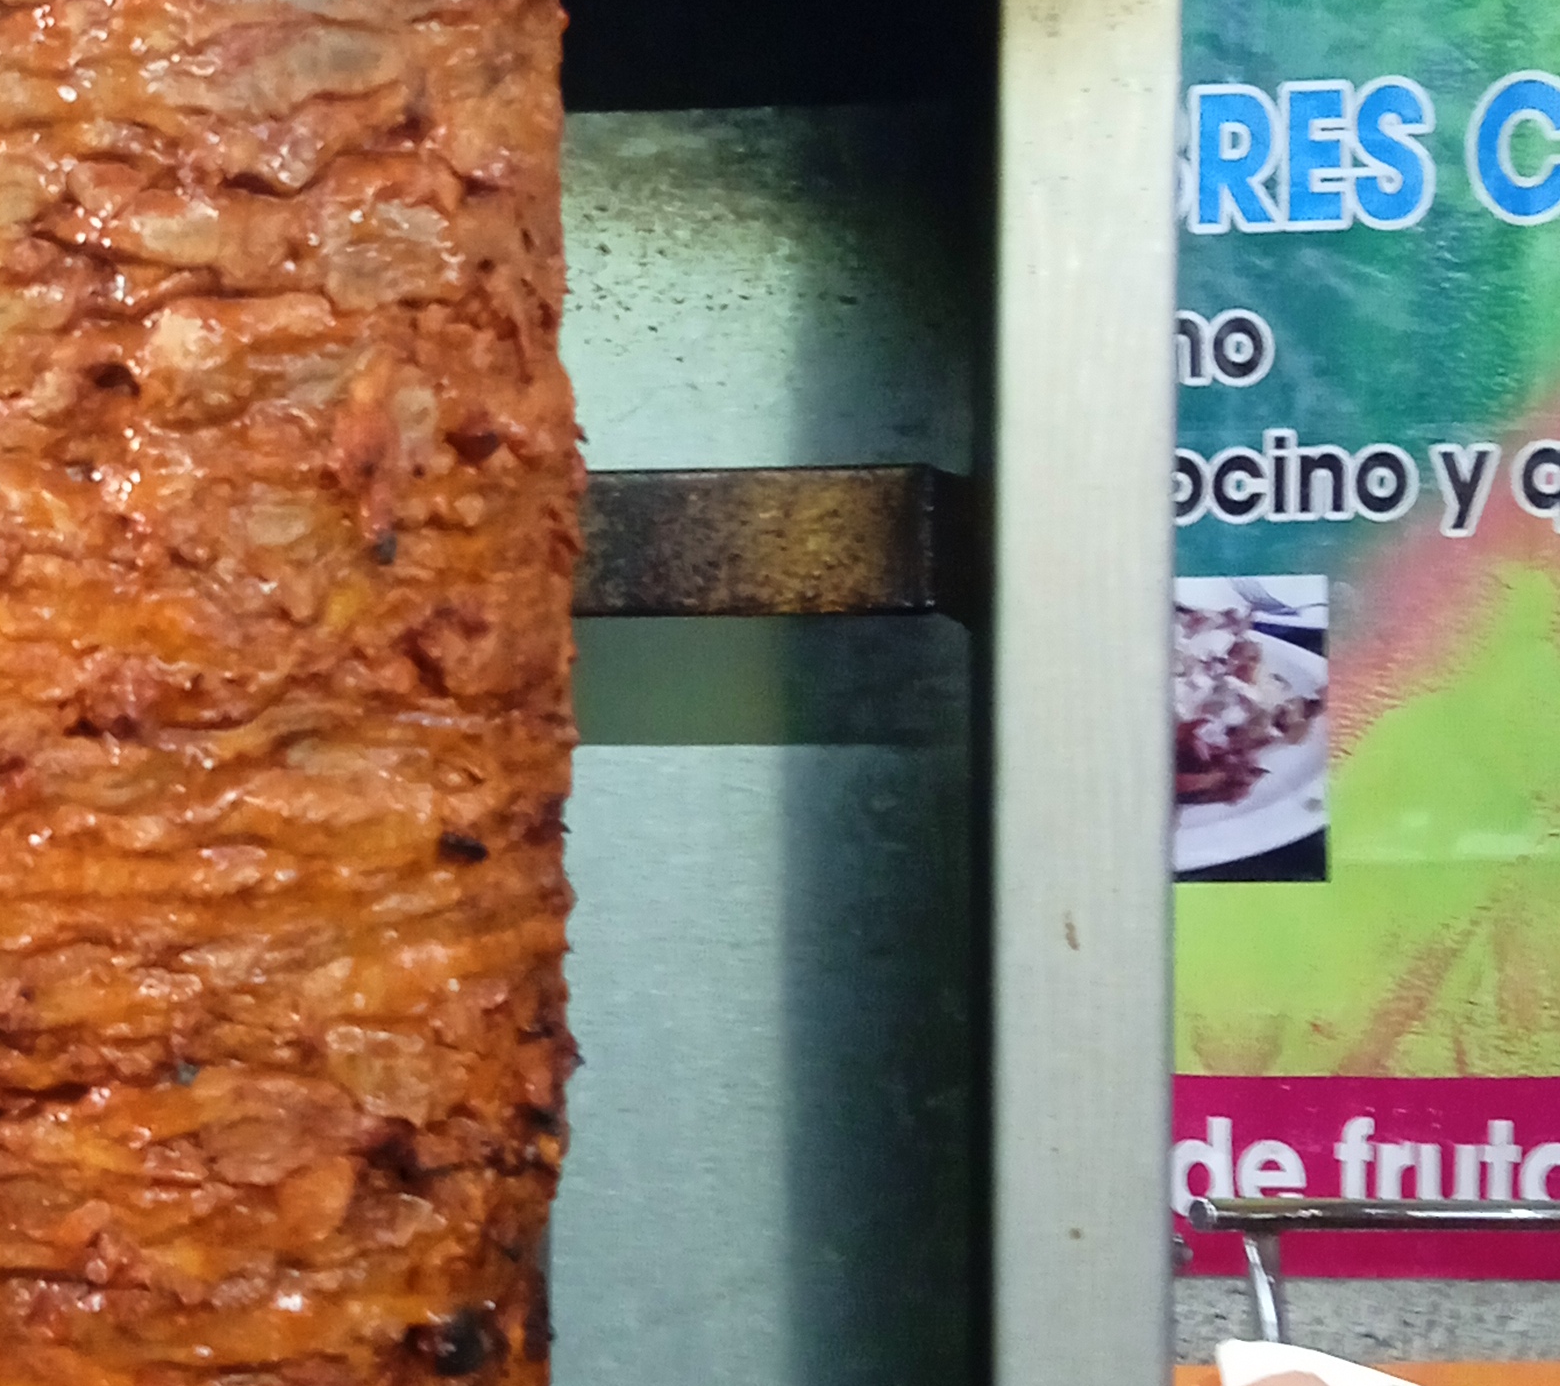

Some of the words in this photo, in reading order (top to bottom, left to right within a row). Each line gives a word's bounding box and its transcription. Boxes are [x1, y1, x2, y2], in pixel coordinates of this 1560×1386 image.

[1187, 79, 1428, 226] RES
[1438, 449, 1492, 531] y
[1171, 1115, 1308, 1216] de
